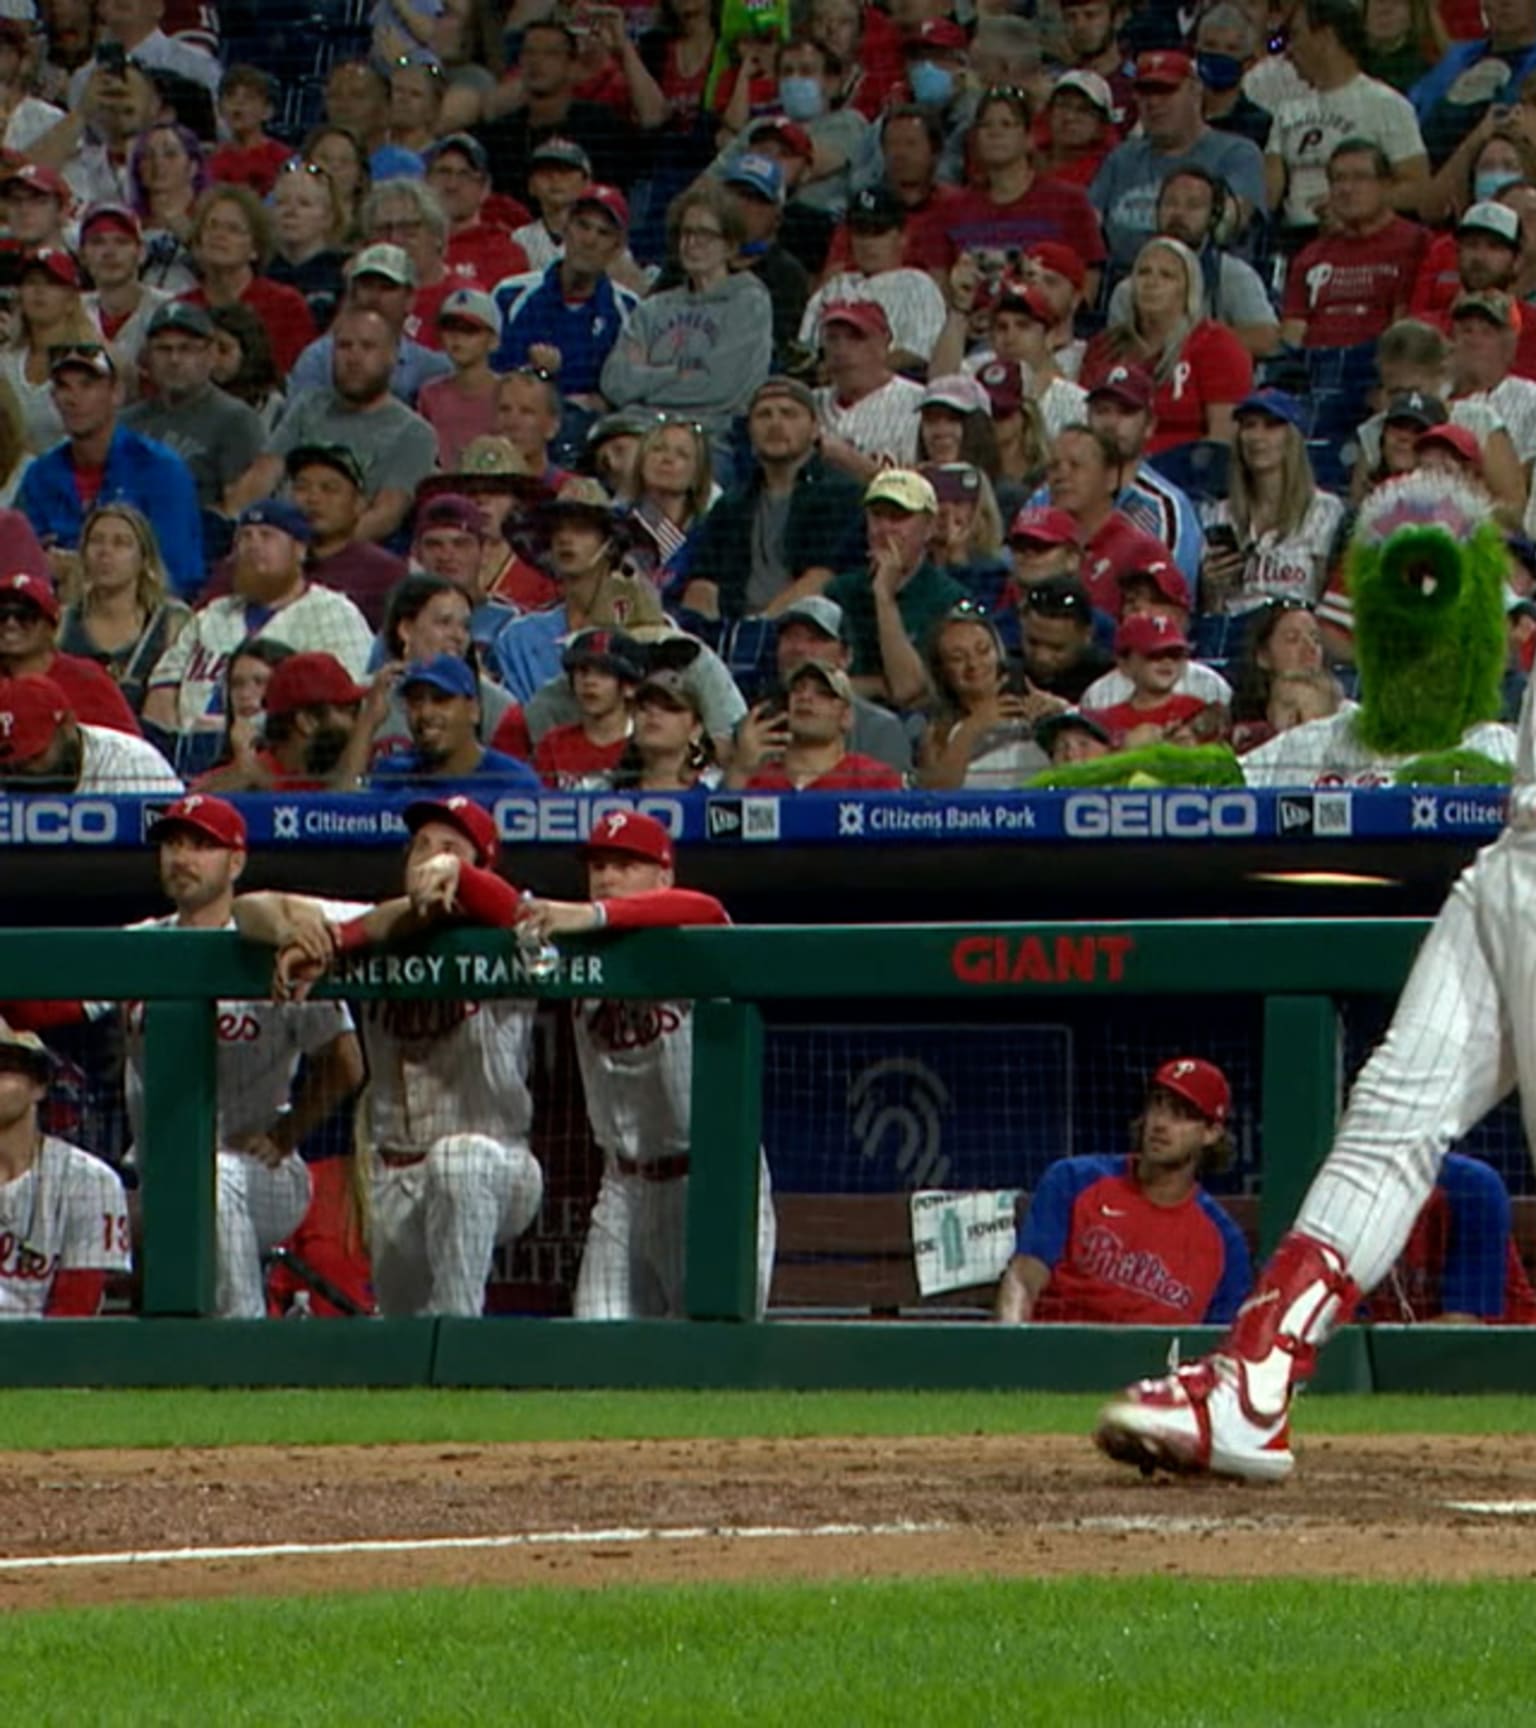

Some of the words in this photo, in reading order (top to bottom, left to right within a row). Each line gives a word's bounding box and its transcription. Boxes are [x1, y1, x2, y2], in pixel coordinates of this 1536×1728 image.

[0, 801, 117, 843] ICO
[305, 809, 378, 834] Citizens
[870, 806, 943, 830] Citizens
[945, 806, 991, 828] Bank
[995, 805, 1037, 828] Park
[1064, 793, 1258, 838] GEICO
[952, 935, 1134, 984] GIANT
